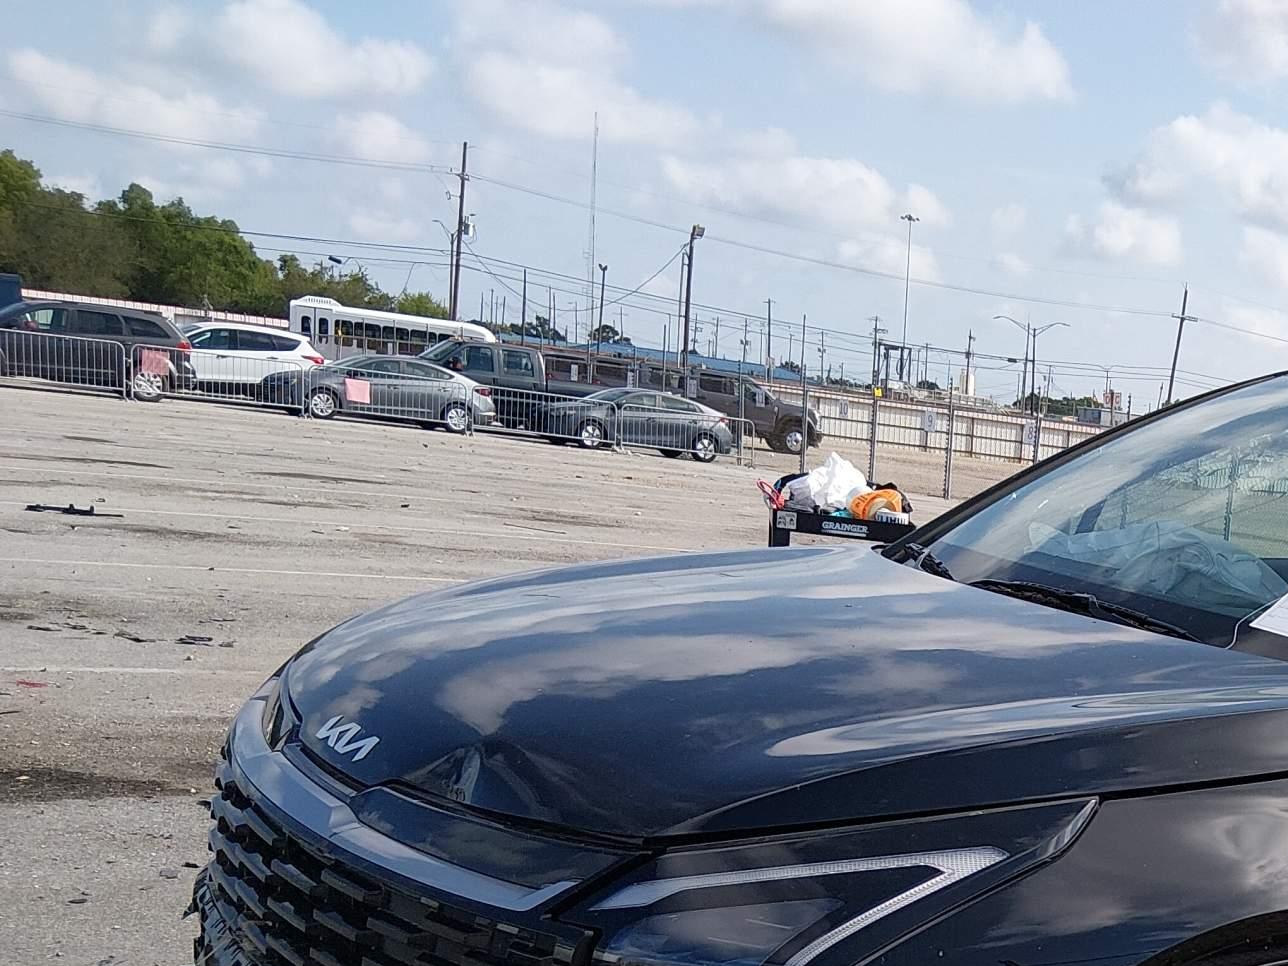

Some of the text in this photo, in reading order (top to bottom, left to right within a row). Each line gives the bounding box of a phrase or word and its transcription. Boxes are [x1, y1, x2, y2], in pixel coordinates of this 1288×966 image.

[839, 401, 849, 416] 10
[927, 414, 934, 428] 9
[822, 521, 869, 534] GRAINGER
[315, 714, 381, 762] KIA
